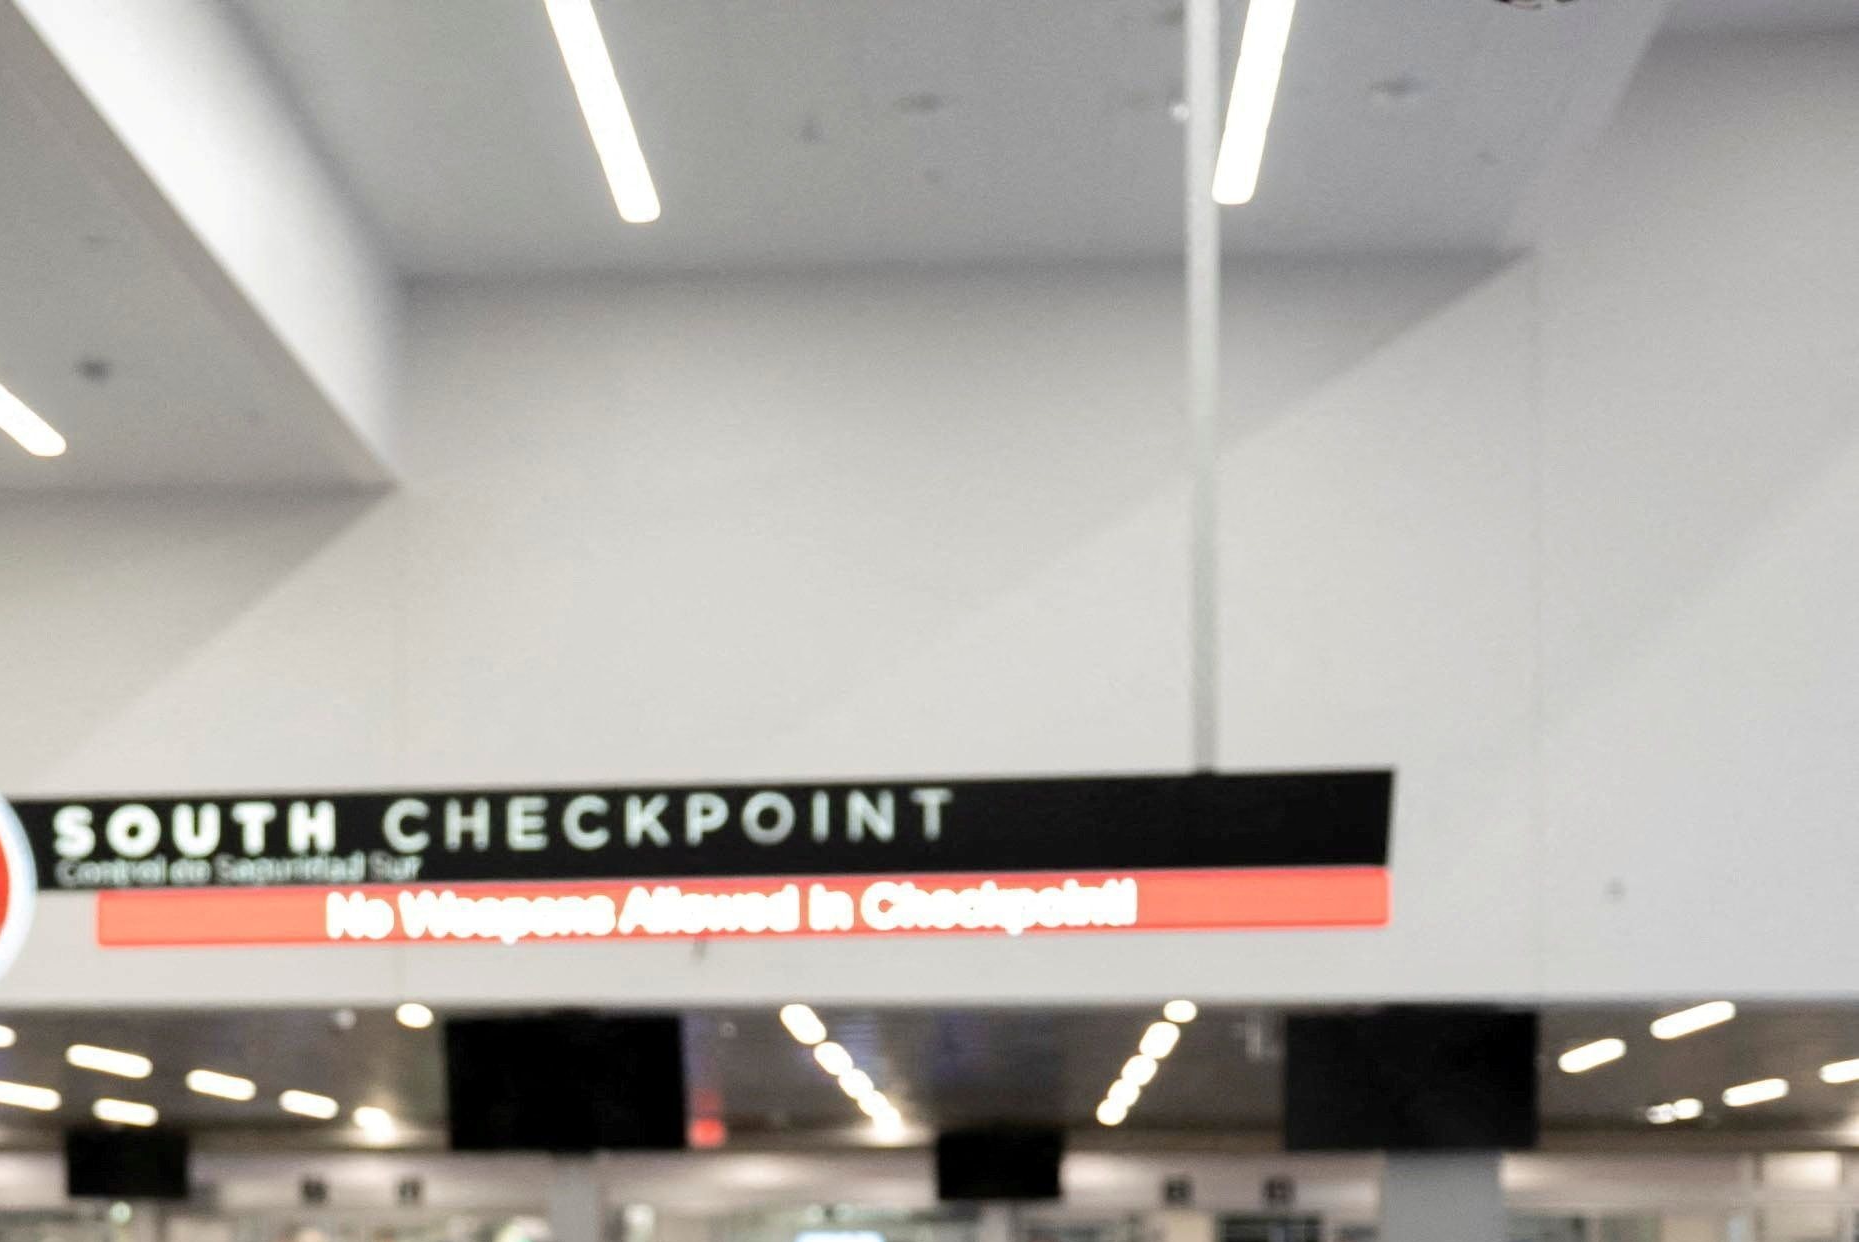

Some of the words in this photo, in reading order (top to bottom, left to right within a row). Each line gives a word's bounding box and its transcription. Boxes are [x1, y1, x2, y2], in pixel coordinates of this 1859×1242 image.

[52, 800, 339, 860] SOUTH
[384, 788, 953, 854] CHECKPOINT
[325, 891, 394, 939] No
[398, 889, 616, 945] Weapons
[618, 884, 800, 934] Allowed
